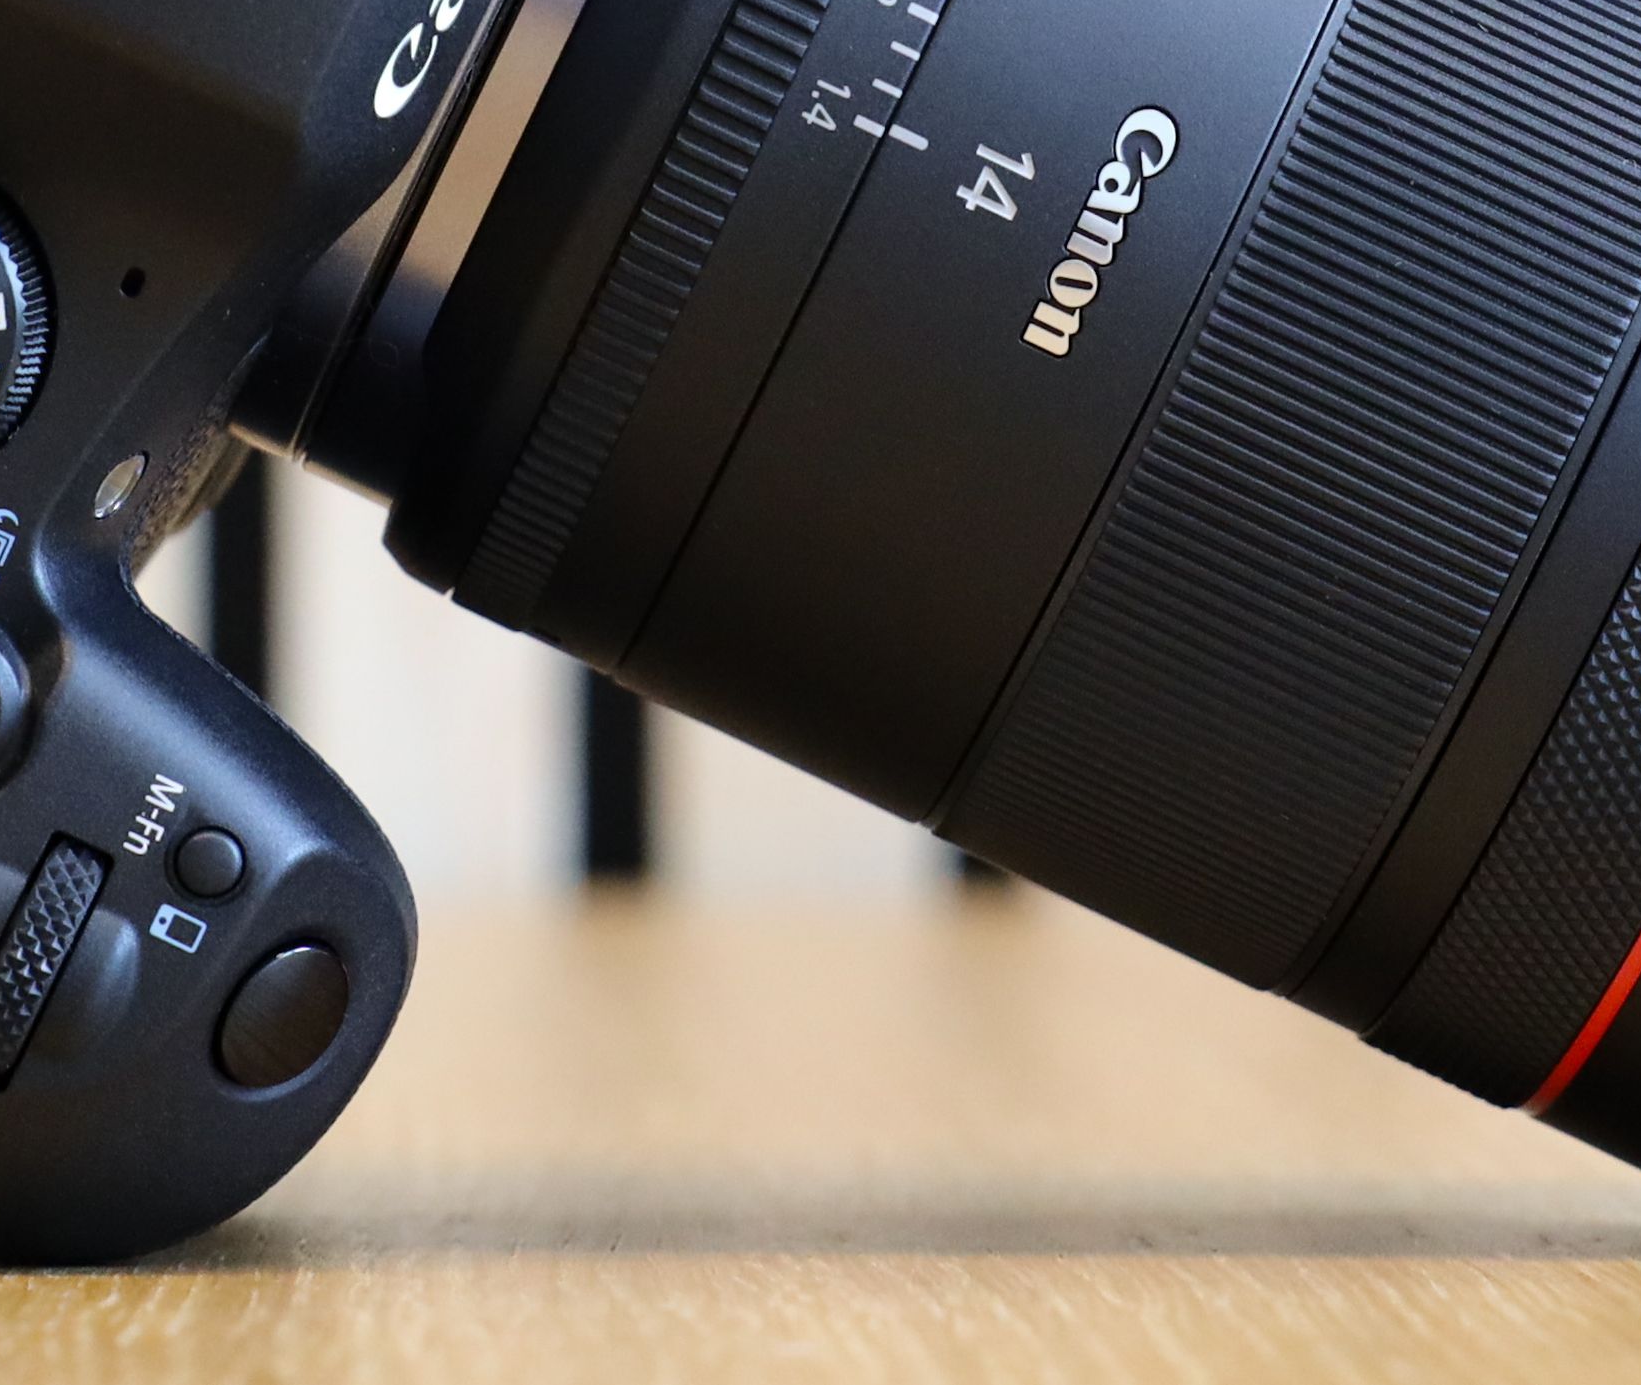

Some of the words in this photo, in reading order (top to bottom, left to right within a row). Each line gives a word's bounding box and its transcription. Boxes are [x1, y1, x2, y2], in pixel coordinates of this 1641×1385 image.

[801, 79, 852, 132] 1.4
[955, 142, 1036, 222] 14
[1019, 105, 1179, 358] Canon
[122, 773, 185, 856] M-Fn
